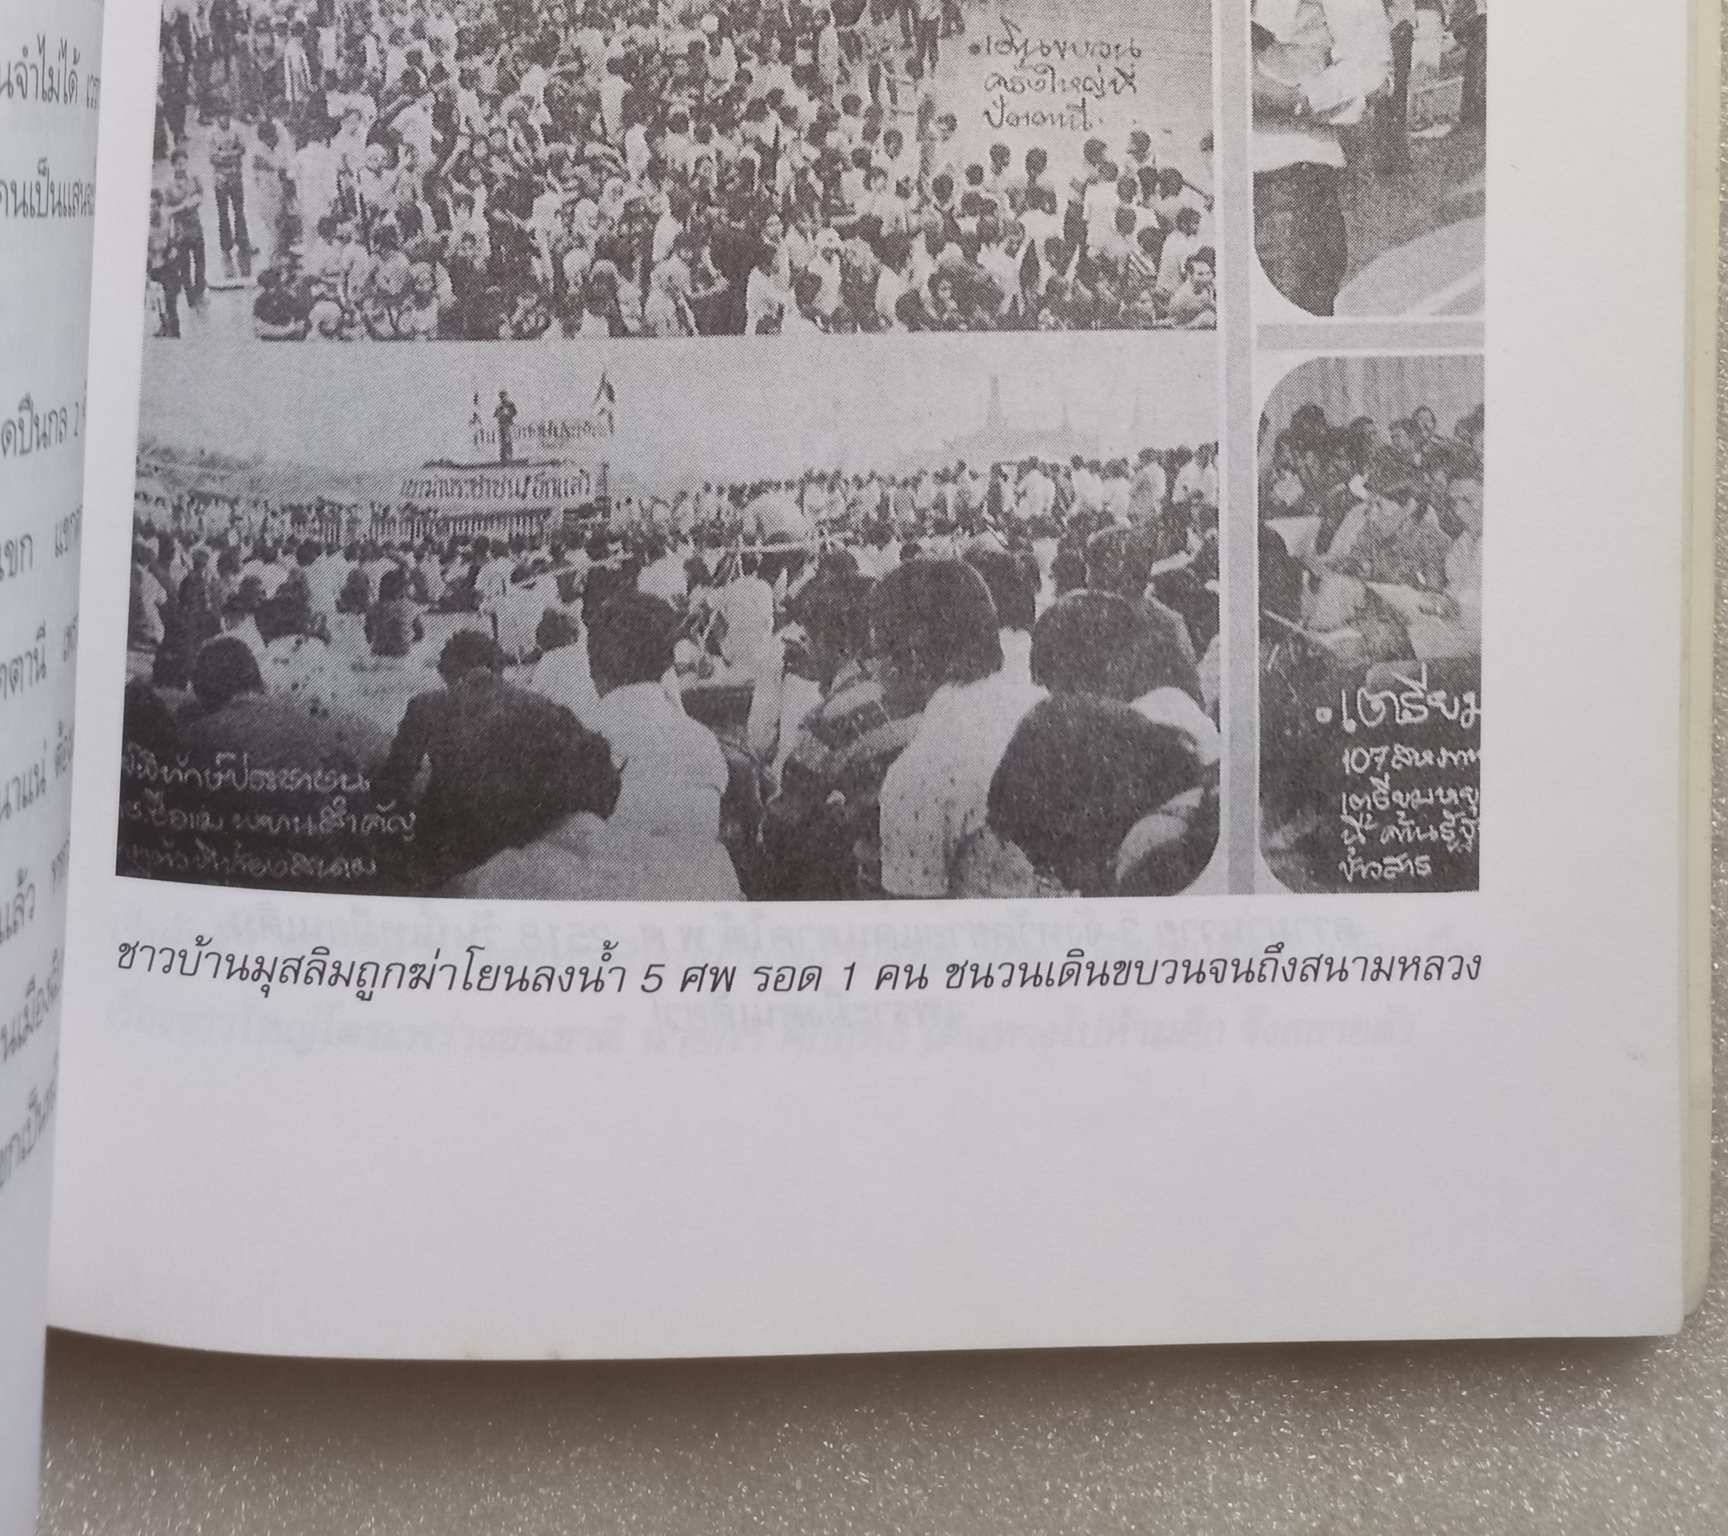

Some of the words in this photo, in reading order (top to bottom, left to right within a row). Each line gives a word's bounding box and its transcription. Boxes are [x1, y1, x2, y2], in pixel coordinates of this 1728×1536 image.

[117, 933, 627, 1002] ชาวบ้านมุสลิมถูกฆ่าโยนลงน้ำ
[639, 962, 665, 994] 5
[680, 958, 737, 994] ศพ
[752, 960, 823, 995] รอด
[841, 960, 856, 992] 1
[873, 959, 929, 992] คน
[945, 939, 1483, 991] ชนวนเดินขบวนจนถึงสนามหลวง
